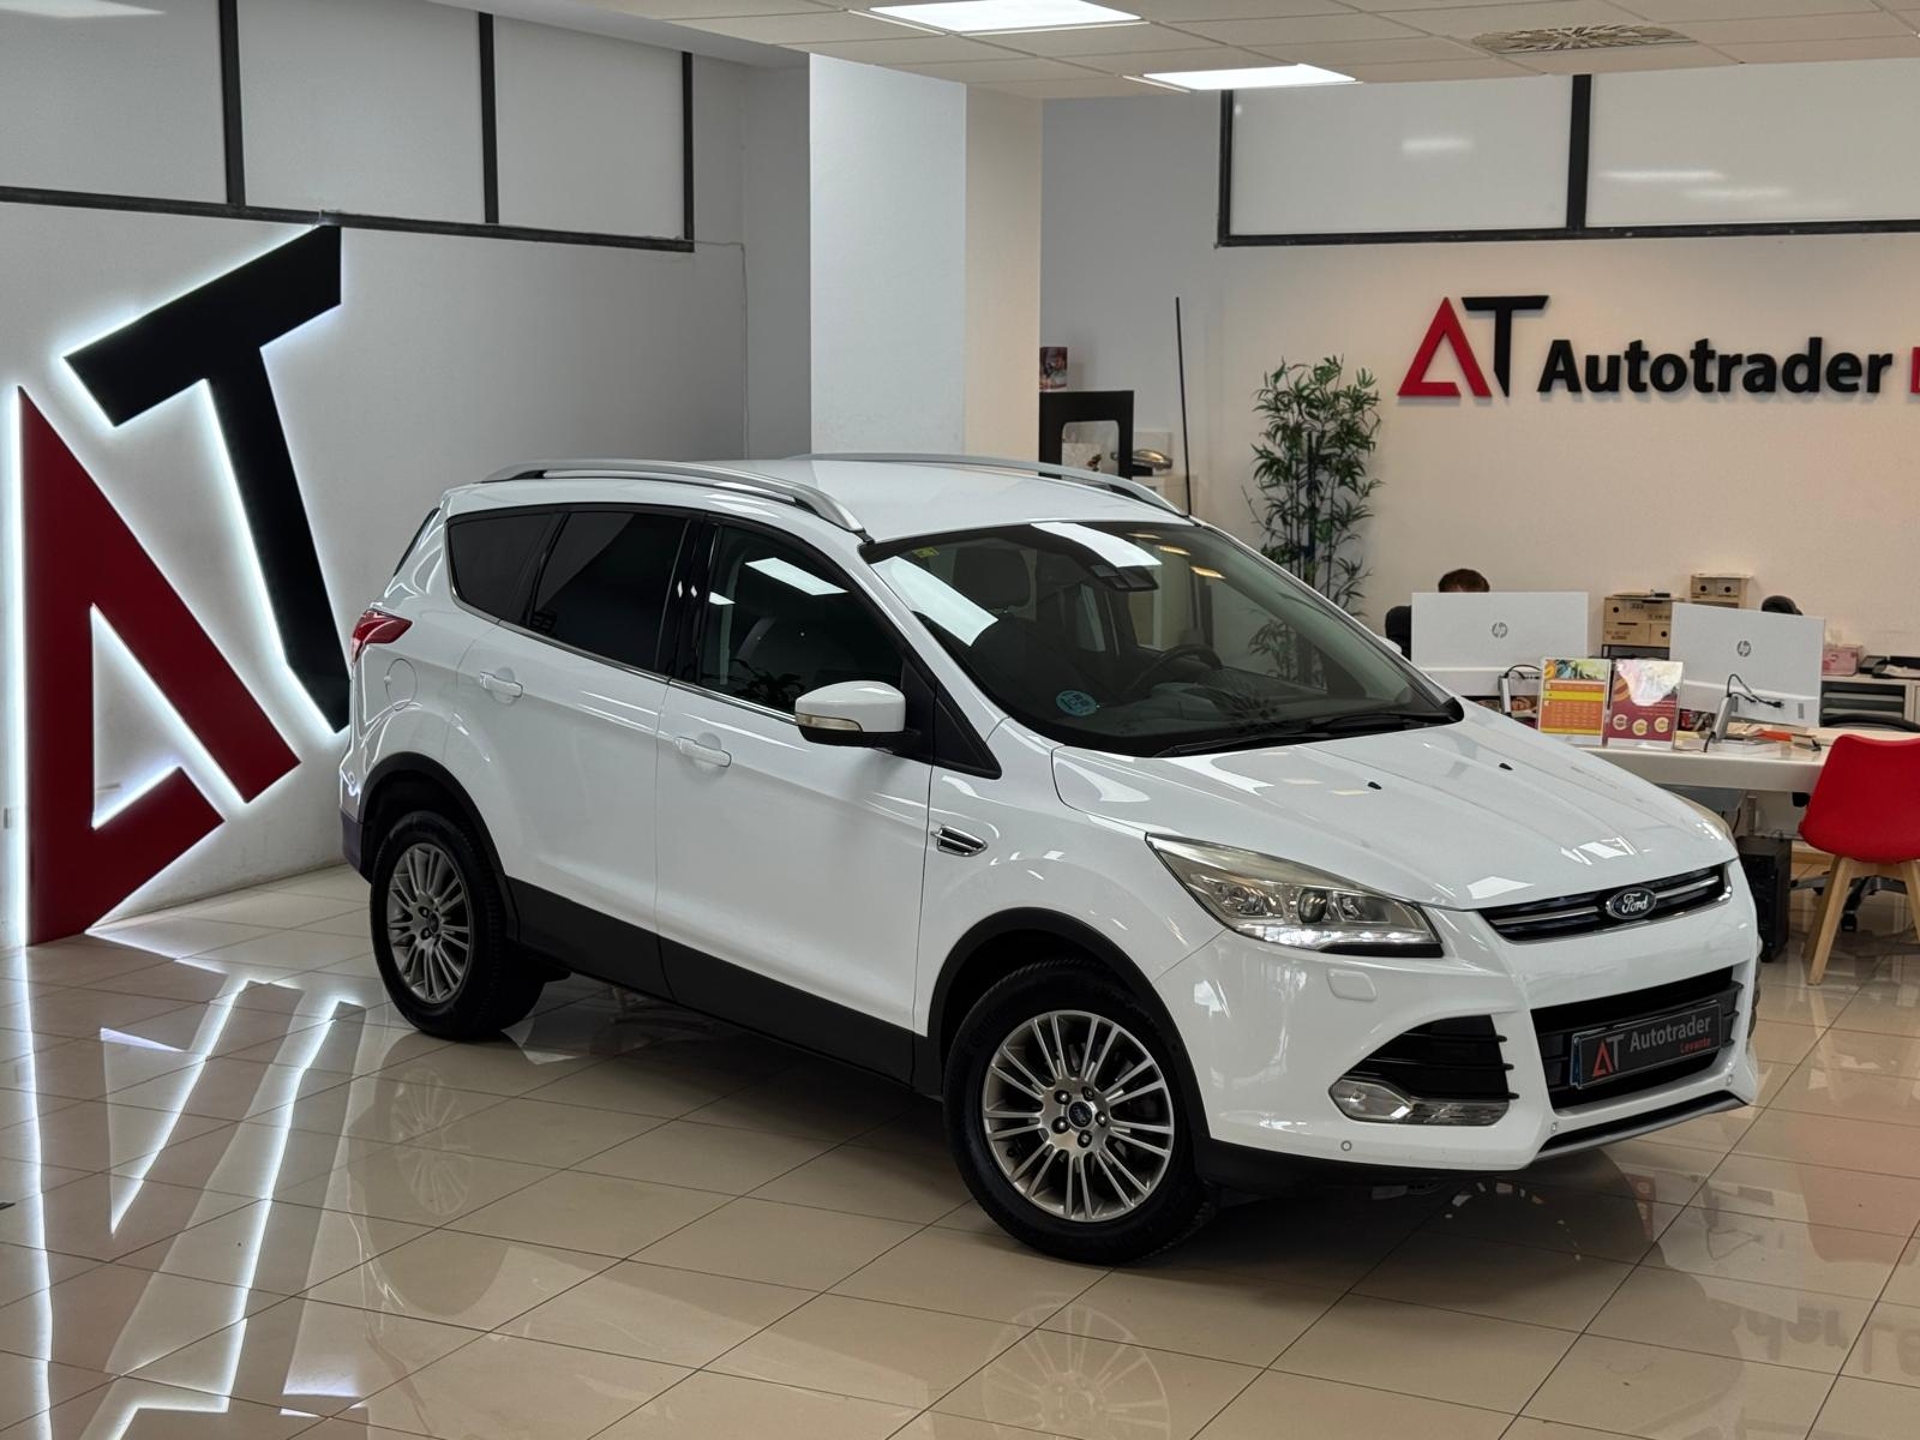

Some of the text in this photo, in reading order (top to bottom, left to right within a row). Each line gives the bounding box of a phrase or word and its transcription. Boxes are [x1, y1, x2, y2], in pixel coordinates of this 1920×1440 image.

[1398, 295, 1549, 397] AT
[1537, 337, 1893, 394] Autotrader
[19, 224, 350, 946] AT
[1622, 893, 1648, 913] Ford
[1592, 1015, 1711, 1077] AT Autotrader
[1679, 1037, 1711, 1054] Levante
